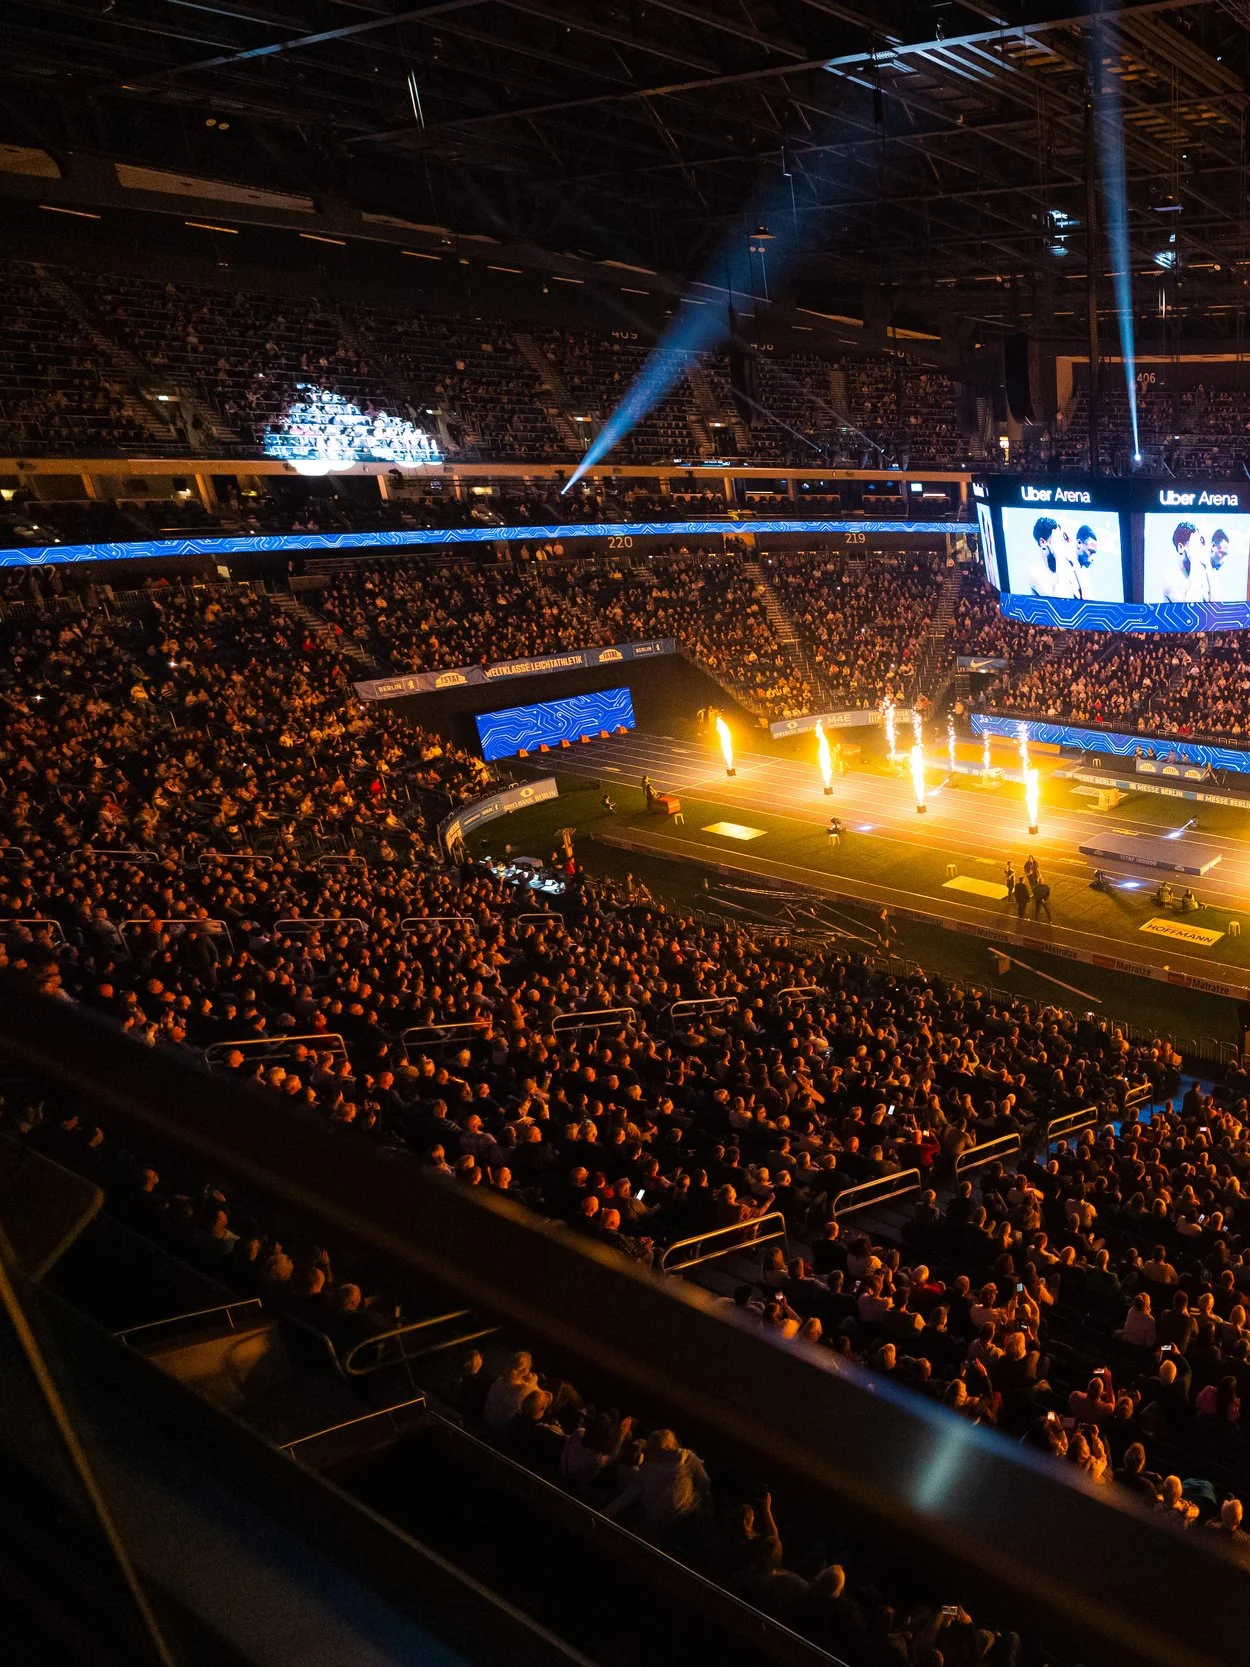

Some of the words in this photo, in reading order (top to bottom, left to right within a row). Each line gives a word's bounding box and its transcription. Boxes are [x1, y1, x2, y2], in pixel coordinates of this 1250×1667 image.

[1136, 372, 1156, 384] 406
[1021, 486, 1052, 502] Uber
[1054, 487, 1091, 503] Arena
[1159, 489, 1196, 506] Uber
[1198, 490, 1239, 506] Arena
[607, 536, 634, 549] 220
[844, 532, 867, 545] 219
[485, 661, 530, 678] WELTKLASSE
[531, 655, 583, 672] LEICHTATHLETIK
[378, 683, 402, 693] BERLIN
[827, 714, 851, 724] M4E
[1137, 784, 1160, 795] MESSE
[1161, 787, 1183, 798] BERLIN
[1205, 795, 1229, 806] MESSE
[1146, 923, 1214, 944] HOFFMANN
[1115, 957, 1152, 976] Matratze
[1192, 979, 1230, 995] Matratze
